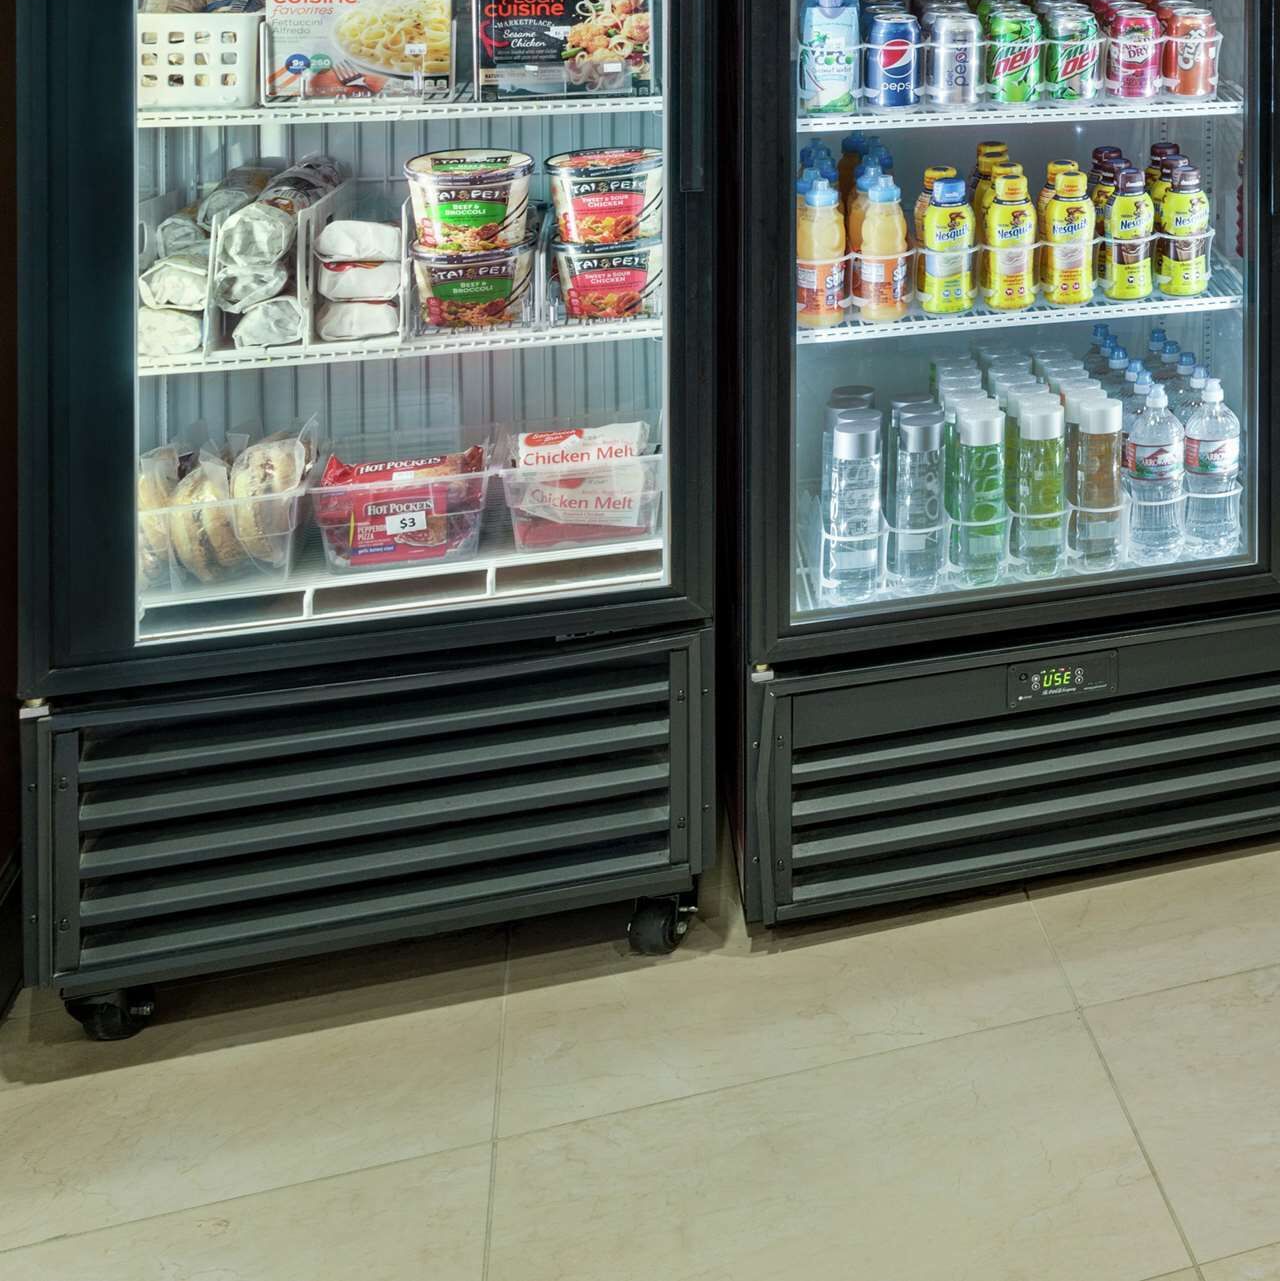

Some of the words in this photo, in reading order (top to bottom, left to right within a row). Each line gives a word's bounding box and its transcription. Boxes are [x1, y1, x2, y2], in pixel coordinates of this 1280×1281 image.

[271, 18, 324, 27] Fettuccini
[496, 18, 553, 29] MARKETPLACE
[503, 29, 537, 39] Sesame
[510, 38, 547, 49] Chicken
[1127, 45, 1148, 58] DRY
[587, 200, 624, 208] CHICKEN
[590, 276, 627, 285] CHICKEN
[523, 450, 592, 468] Chicken
[605, 445, 634, 461] Melt
[360, 462, 386, 475] HOT
[387, 456, 442, 471] POCKETS
[531, 489, 590, 511] Chicken
[594, 494, 633, 511] Melt
[367, 502, 390, 516] HOT
[391, 498, 434, 516] POCKETS
[400, 517, 417, 530] $3
[1042, 671, 1072, 688] USE
